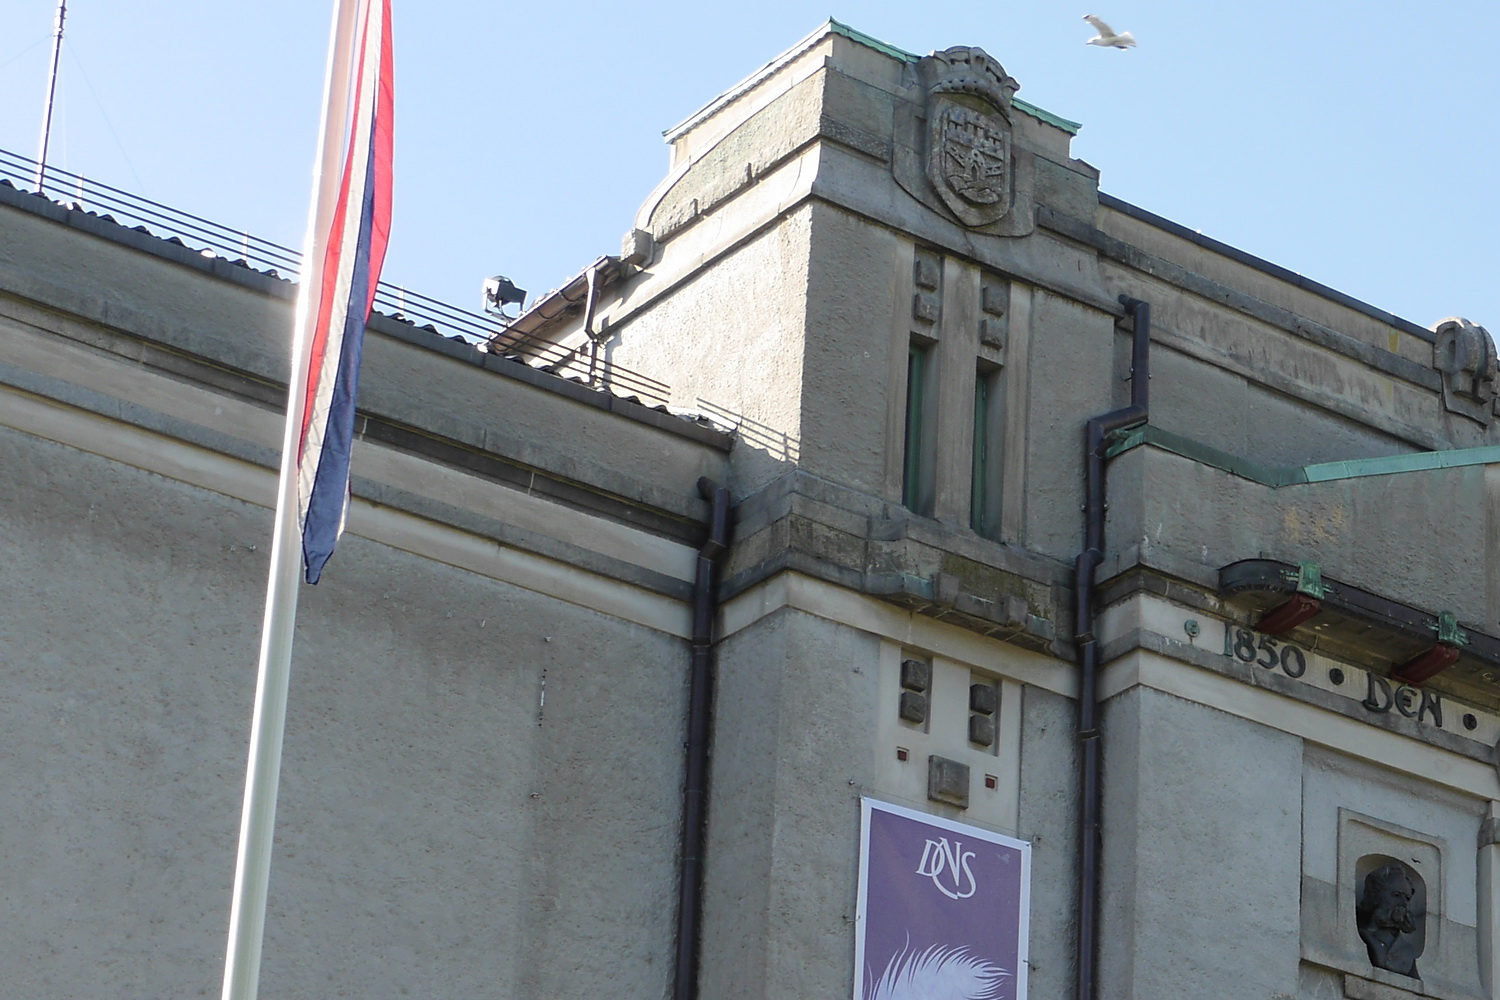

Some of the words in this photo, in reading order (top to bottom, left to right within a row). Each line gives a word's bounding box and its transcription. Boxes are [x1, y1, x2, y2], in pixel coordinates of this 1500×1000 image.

[1223, 621, 1307, 679] 1850
[1362, 671, 1443, 728] DEN
[916, 837, 977, 900] DNS
